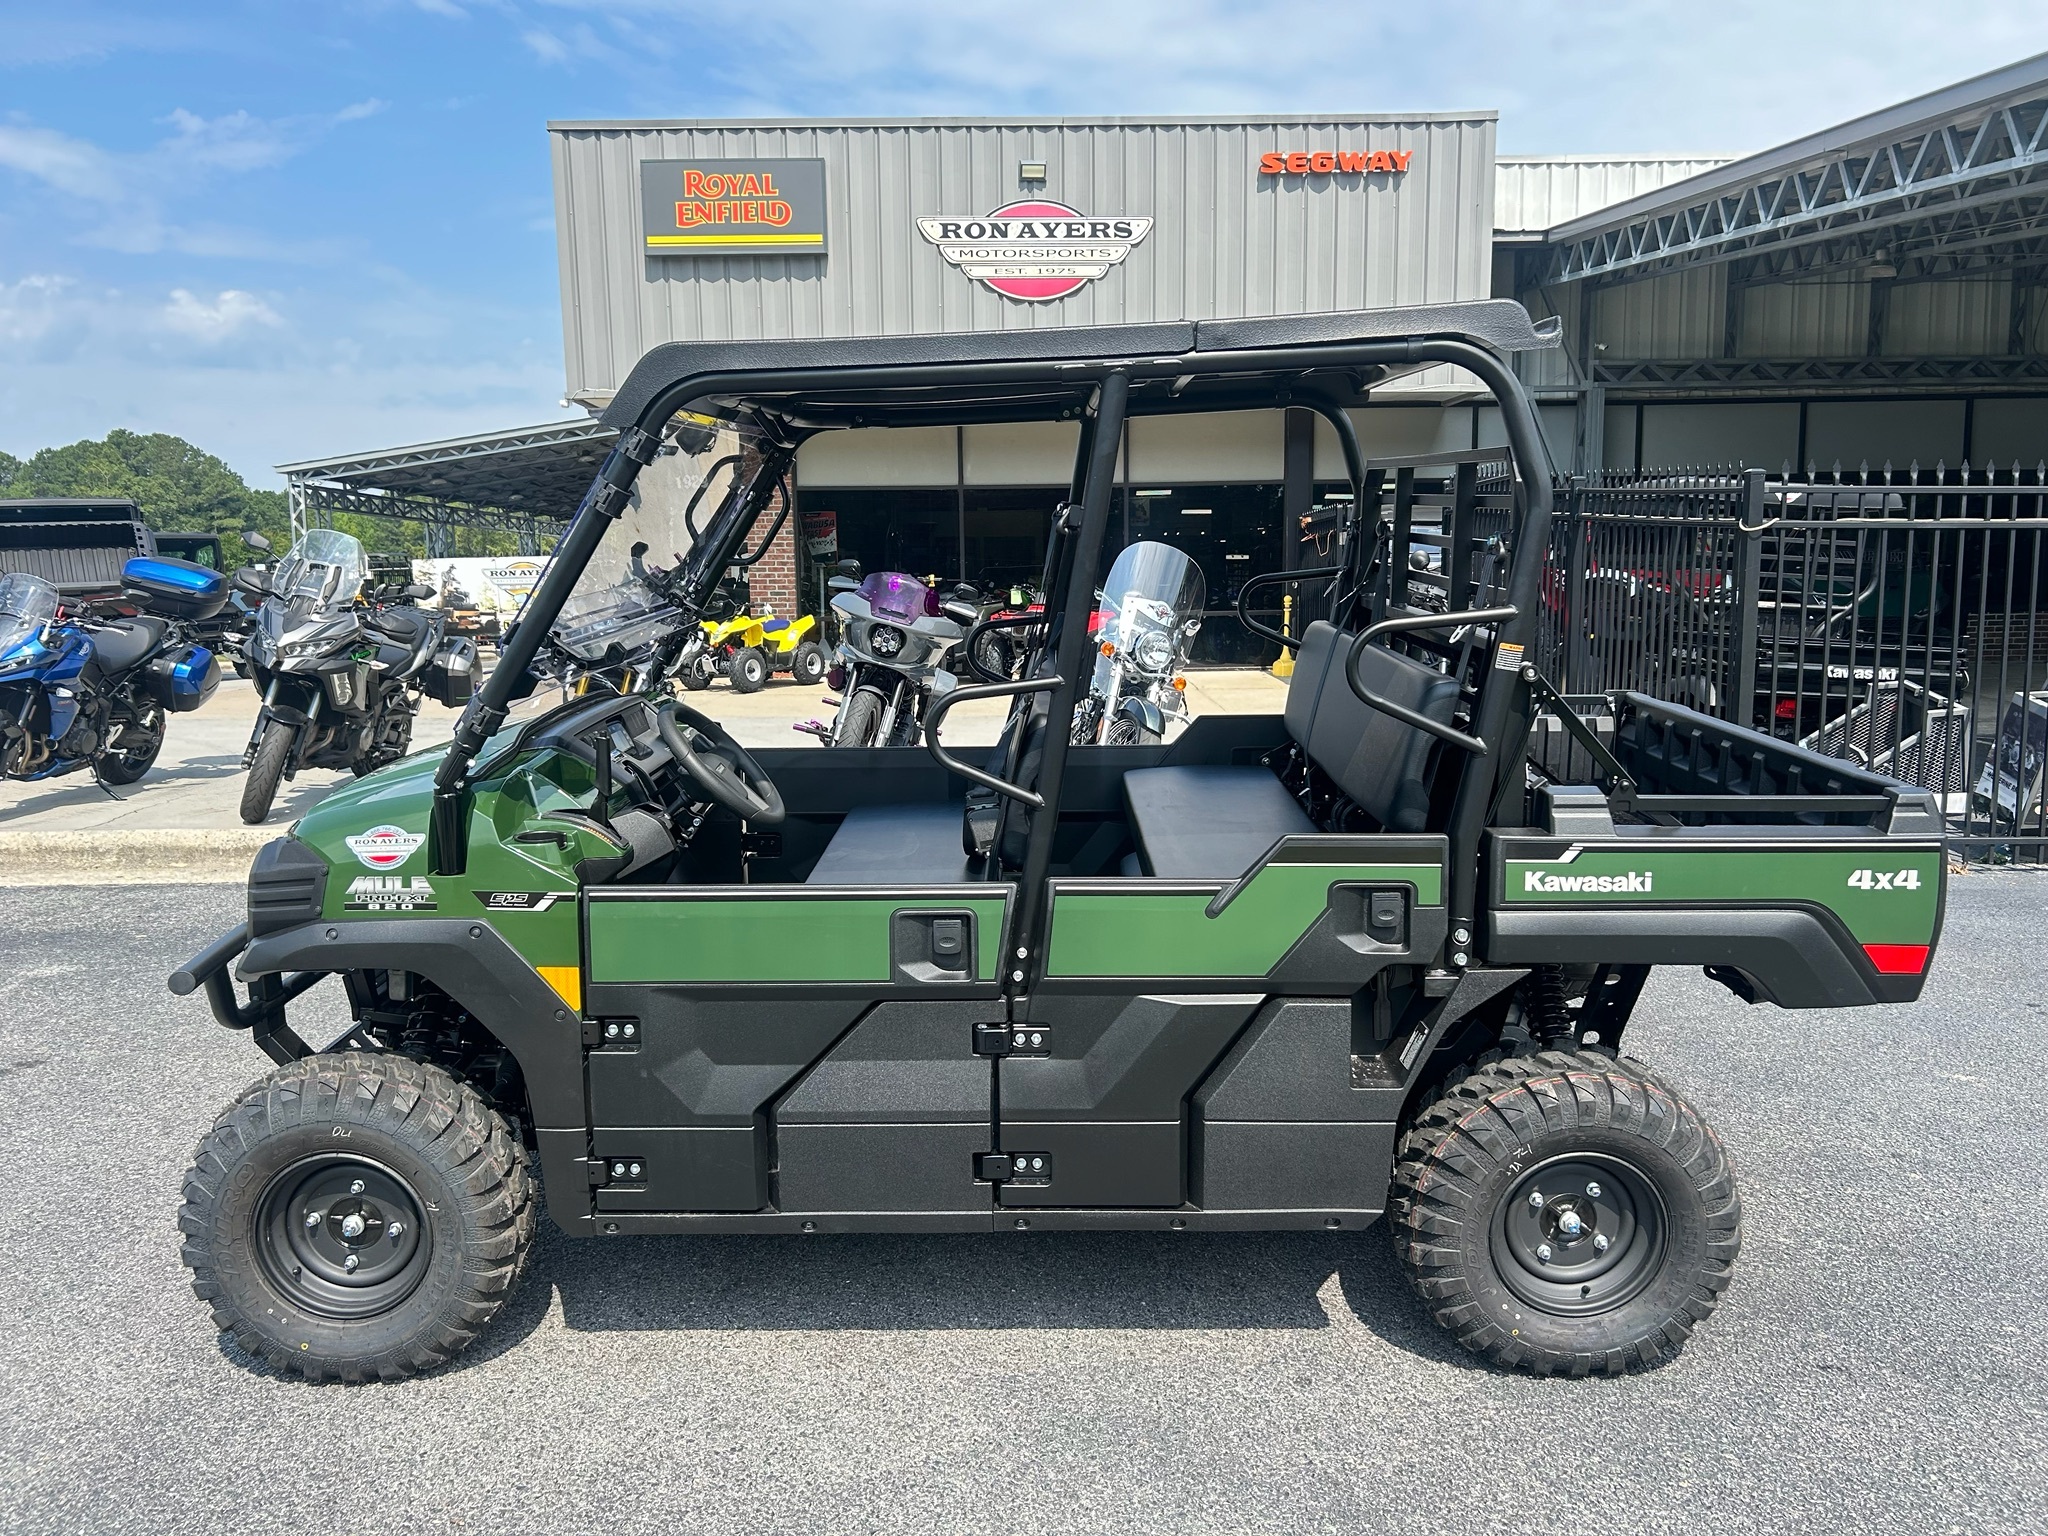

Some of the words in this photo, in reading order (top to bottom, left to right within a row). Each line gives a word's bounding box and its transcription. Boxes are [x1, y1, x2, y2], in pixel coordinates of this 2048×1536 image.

[1260, 150, 1413, 174] SEGWAY
[683, 170, 779, 199] ROYAL
[675, 200, 792, 228] ENFIELD
[939, 222, 1011, 239] RON
[1016, 221, 1133, 239] AYERS
[959, 248, 1112, 258] MOTORSPORTS
[1037, 267, 1076, 275] 1975
[489, 569, 517, 578] RON
[519, 569, 540, 577] AYE
[345, 876, 436, 894] MULE
[1524, 871, 1653, 892] Kawasaki
[1847, 869, 1921, 890] 4x4
